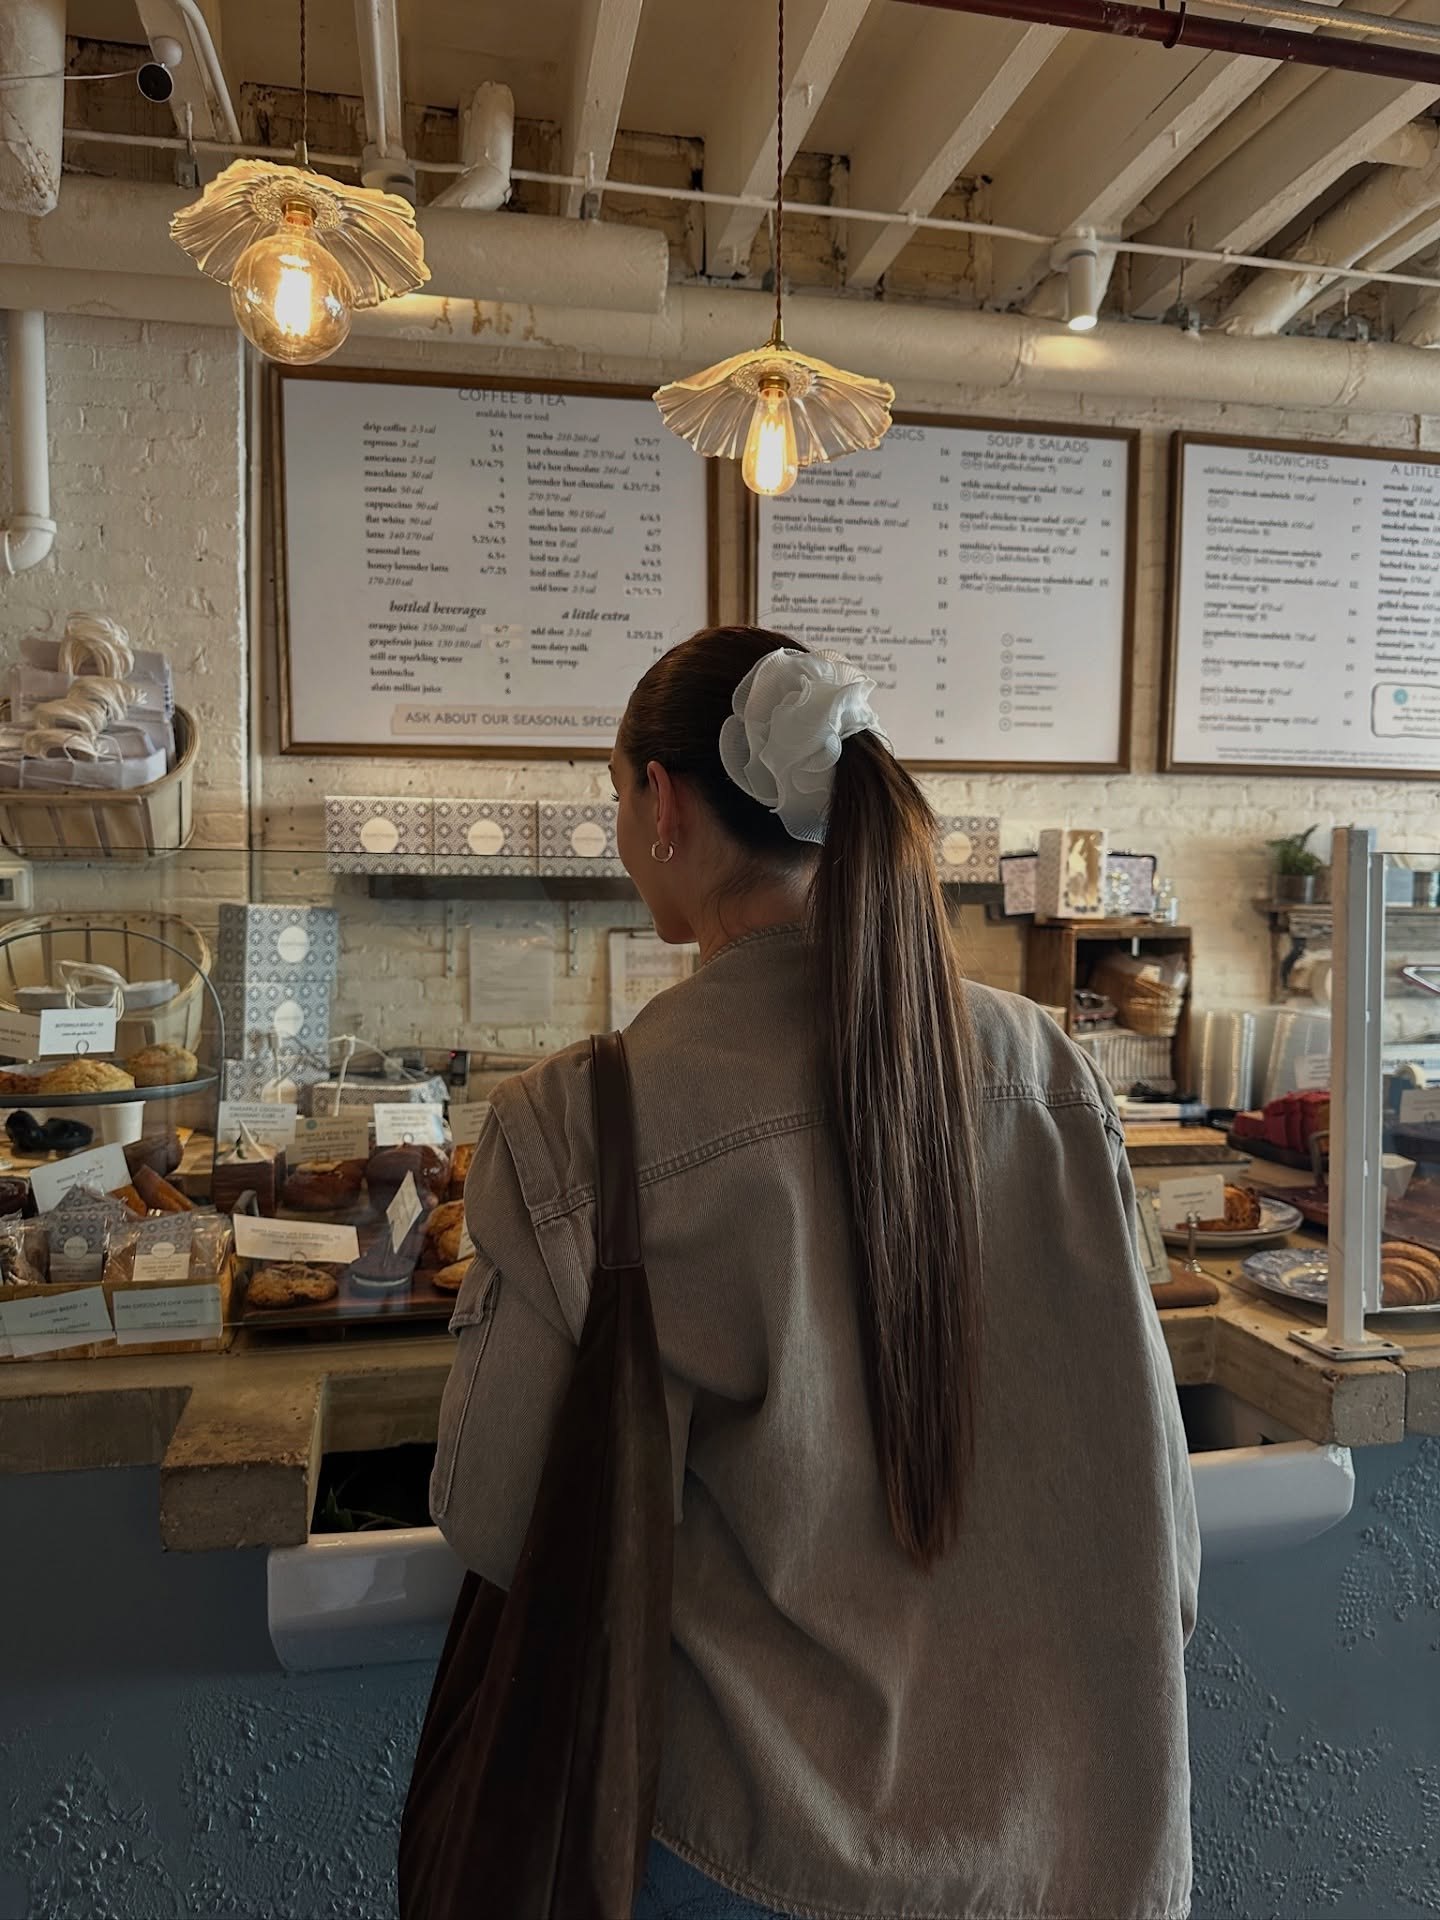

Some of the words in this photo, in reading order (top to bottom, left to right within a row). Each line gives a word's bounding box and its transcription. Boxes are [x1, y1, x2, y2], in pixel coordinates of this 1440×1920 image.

[458, 389, 518, 404] COFFEE
[363, 422, 382, 434] drip
[383, 424, 407, 432] coffee
[363, 440, 398, 449] espresso
[986, 434, 1023, 448] SOUP
[1039, 440, 1089, 453] SALADS
[542, 447, 579, 458] chocolate
[364, 454, 407, 463] americano
[1248, 452, 1329, 470] SANDWICHES
[364, 469, 407, 478] macchiato
[563, 463, 600, 474] chocolate
[1391, 464, 1400, 475] A
[1404, 465, 1440, 479] LITTLE
[364, 485, 397, 494] cortado
[578, 479, 614, 490] chocolate
[366, 500, 413, 510] cappuccino
[366, 514, 379, 524] flat
[382, 515, 405, 524] white
[366, 530, 385, 539] latte
[367, 546, 400, 555] seasonal
[402, 548, 420, 556] latte
[367, 561, 392, 572] honey
[395, 562, 428, 572] lavender
[431, 564, 448, 573] latte
[389, 600, 430, 614] bottled
[433, 603, 486, 618] beverages
[562, 611, 569, 619] a
[572, 609, 599, 621] little
[601, 612, 630, 622] extra
[368, 621, 396, 632] orange
[399, 622, 419, 632] juice
[369, 638, 412, 647] grapefruit
[414, 639, 433, 648] juice
[369, 652, 386, 661] still
[400, 653, 438, 664] sparkling
[441, 655, 463, 663] water
[370, 667, 414, 677] kombucha
[423, 684, 442, 694] juice
[406, 712, 431, 724] ASK
[435, 712, 477, 724] ABOUT
[481, 714, 509, 725] OUR
[512, 714, 578, 726] SEASONAL
